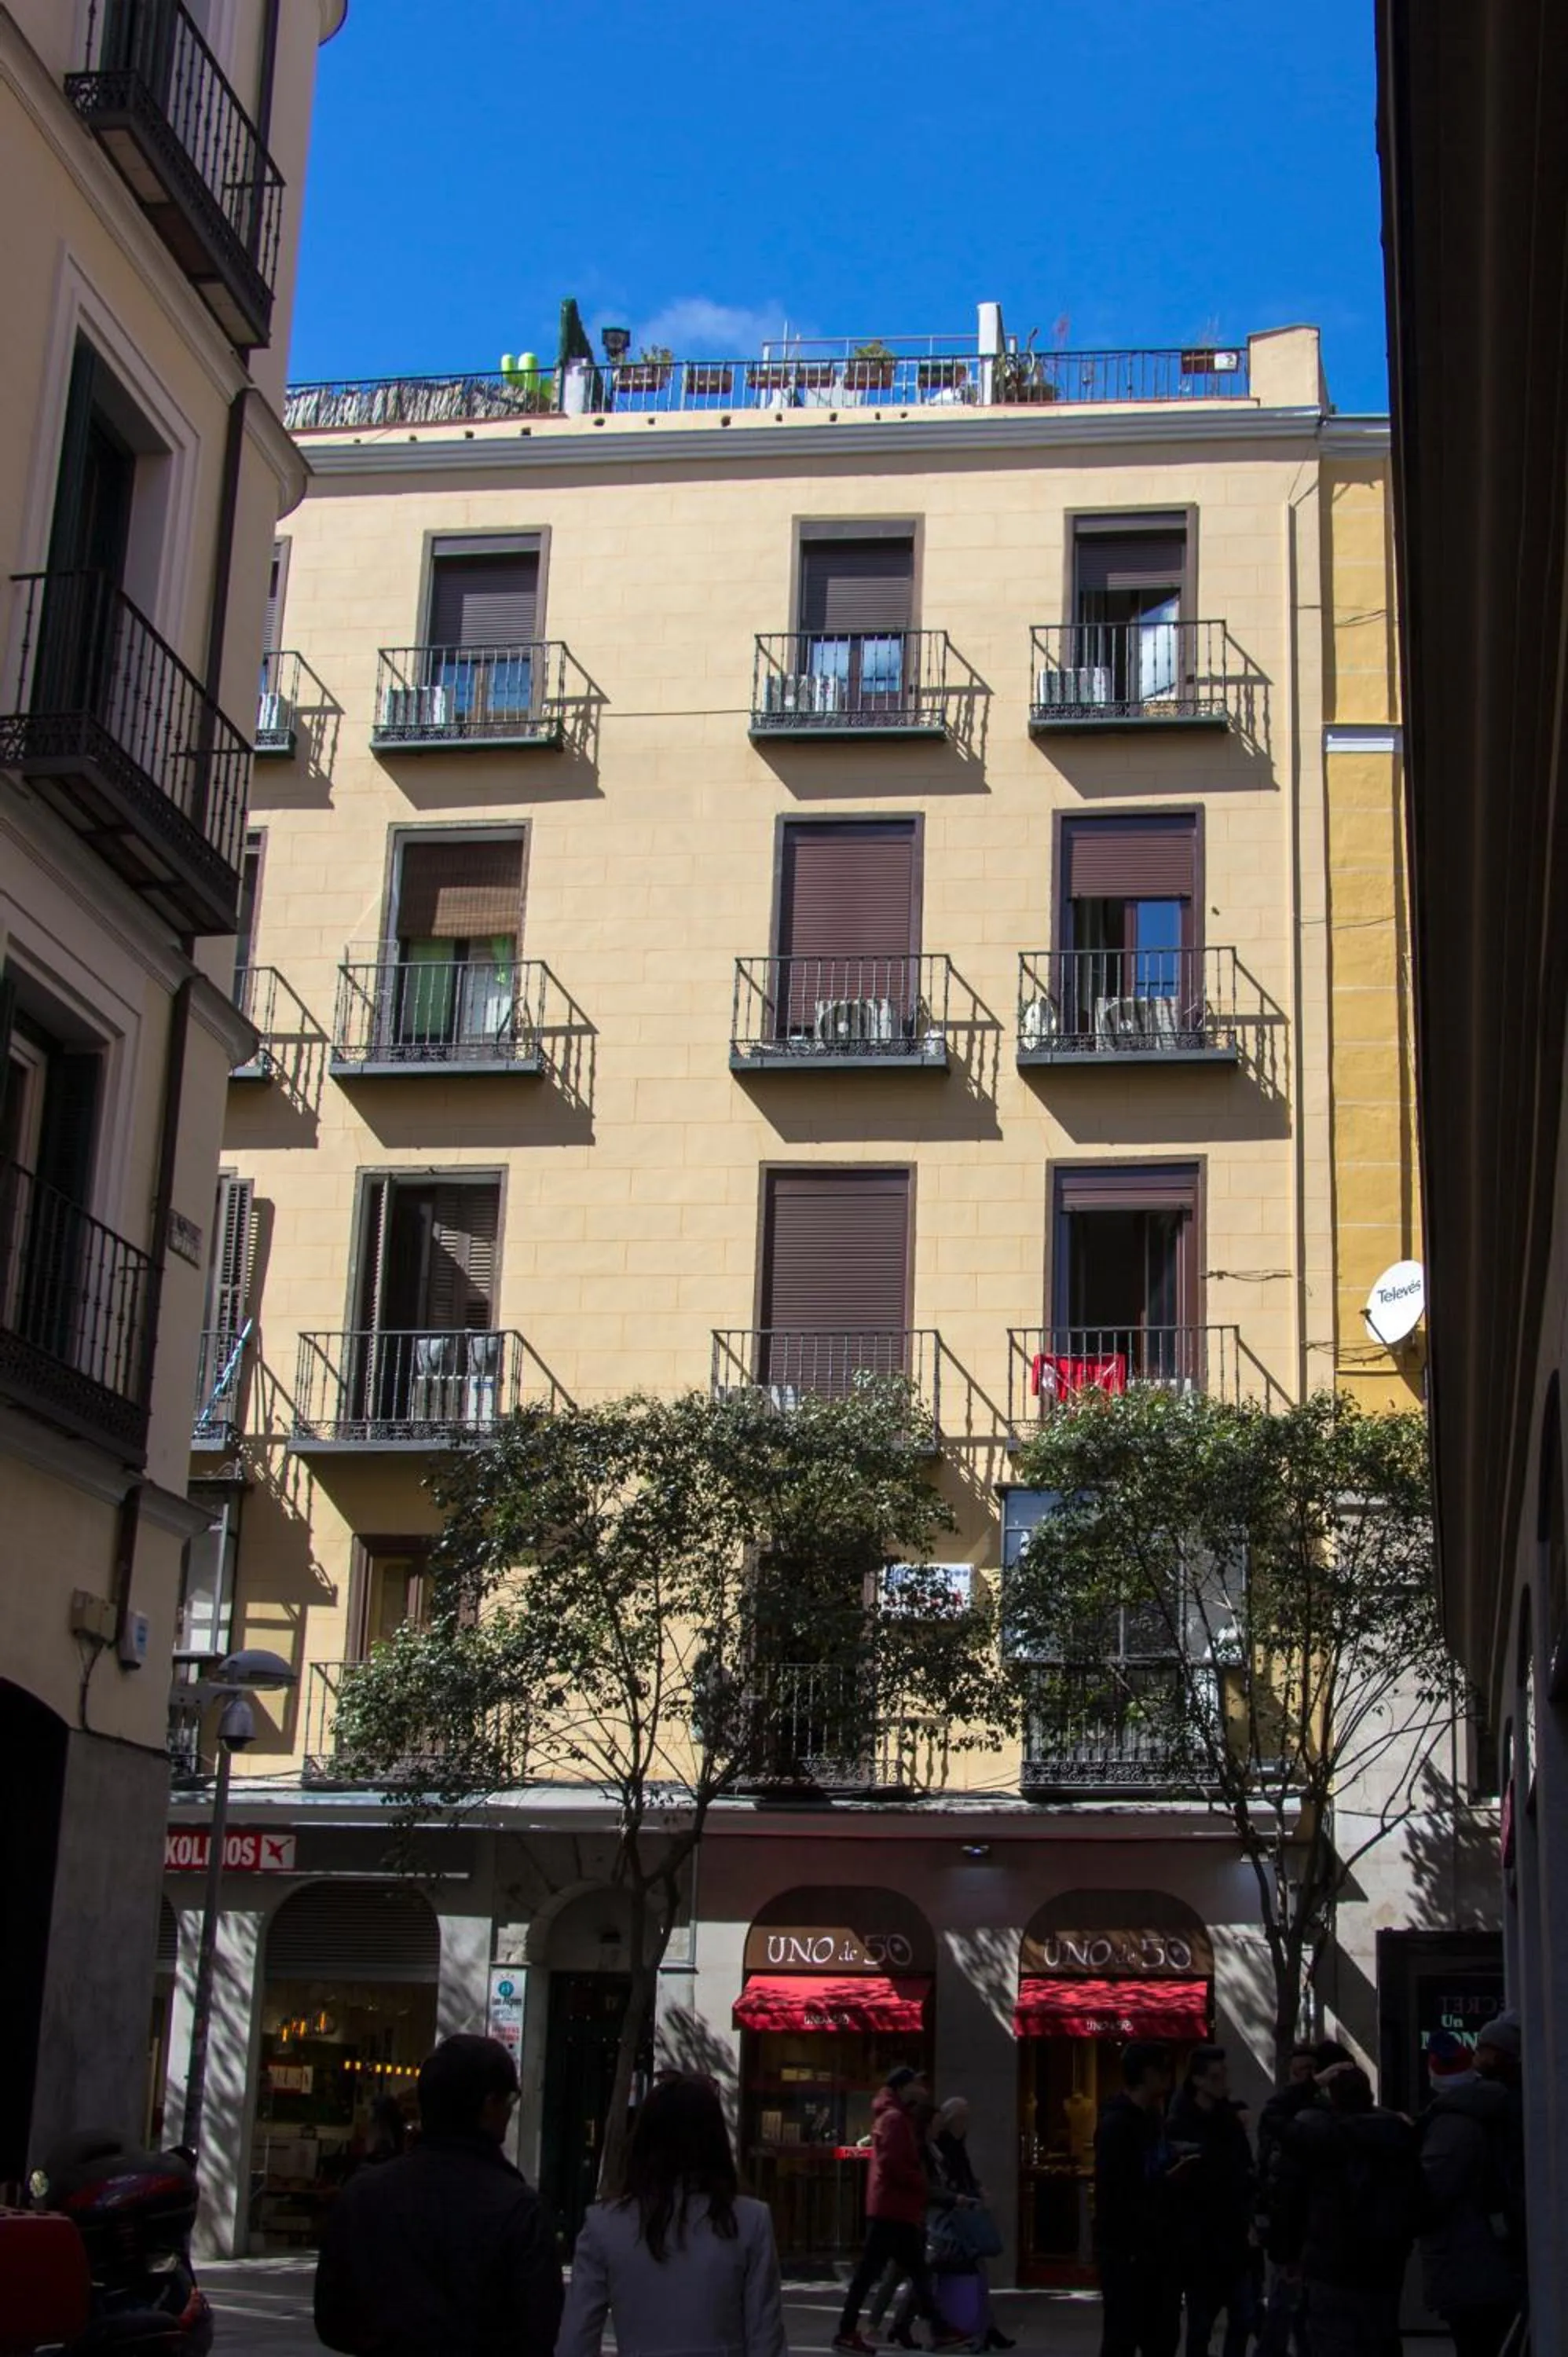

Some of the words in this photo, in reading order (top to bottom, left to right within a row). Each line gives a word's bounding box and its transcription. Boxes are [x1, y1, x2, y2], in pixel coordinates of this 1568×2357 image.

[1376, 1279, 1421, 1304] Televés
[163, 1835, 256, 1867] KOLIOS
[767, 1935, 834, 1964] UNO
[838, 1940, 858, 1961] de
[863, 1934, 912, 1967] 50
[1043, 1938, 1112, 1967] UNO
[1140, 1937, 1192, 1970] 50
[1440, 2013, 1465, 2029] Un
